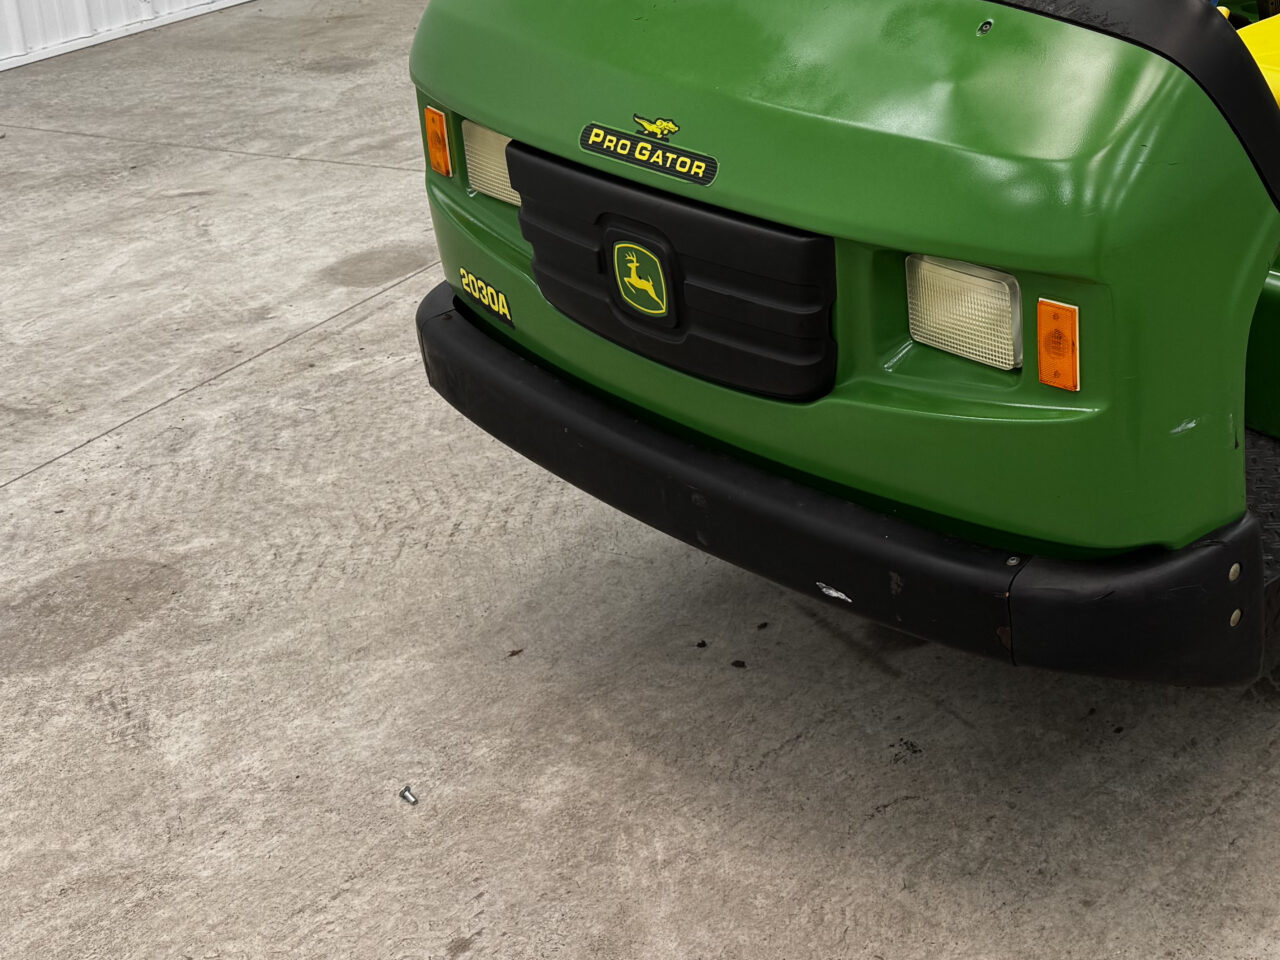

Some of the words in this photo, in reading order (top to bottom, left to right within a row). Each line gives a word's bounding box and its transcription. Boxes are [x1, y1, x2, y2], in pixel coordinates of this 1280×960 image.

[588, 128, 631, 155] PRO
[634, 142, 706, 178] GATOR
[460, 267, 511, 321] 2030A
